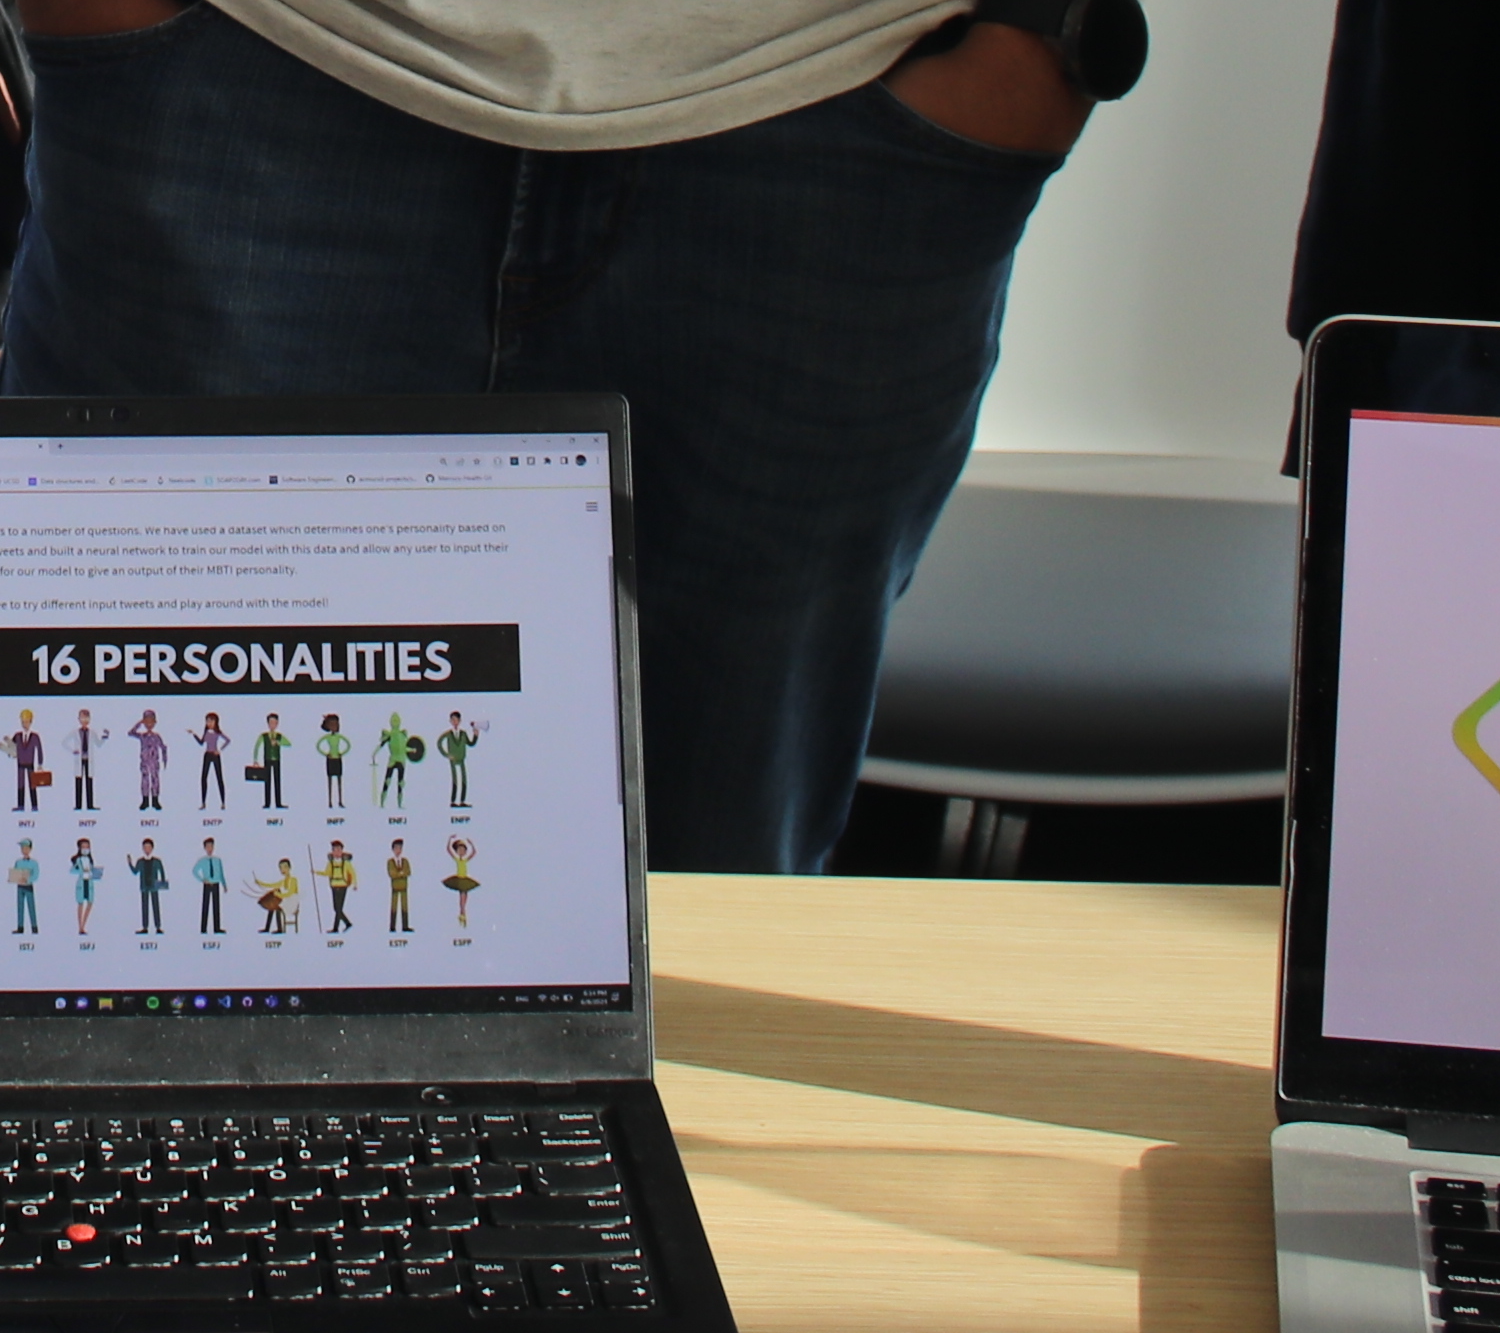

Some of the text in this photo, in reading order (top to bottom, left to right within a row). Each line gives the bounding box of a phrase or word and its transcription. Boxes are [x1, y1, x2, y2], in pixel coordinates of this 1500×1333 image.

[21, 527, 28, 536] a
[219, 526, 225, 535] a
[27, 546, 47, 556] and
[50, 546, 74, 556] built
[77, 548, 83, 556] a
[86, 546, 119, 556] neural
[122, 545, 166, 556] network
[168, 545, 179, 555] to
[182, 545, 206, 555] train
[209, 547, 227, 555] our
[230, 545, 263, 555] model
[266, 544, 289, 555] with
[291, 544, 311, 555] this
[313, 544, 337, 554] data
[339, 544, 359, 554] and
[363, 544, 390, 554] allow
[393, 544, 412, 556] any
[415, 545, 437, 554] user
[440, 543, 451, 554] to
[453, 543, 481, 555] input
[484, 543, 508, 553] their
[0, 566, 14, 576] for
[17, 568, 35, 576] our
[38, 566, 72, 576] model
[74, 566, 85, 576] to
[87, 566, 109, 578] give
[112, 567, 125, 576] an
[127, 565, 164, 578] output
[166, 565, 177, 575] of
[179, 565, 204, 575] their
[207, 565, 233, 575] MBTI
[236, 565, 297, 577] personality.
[10, 600, 20, 610] to
[23, 600, 38, 612] try
[41, 600, 86, 610] different
[89, 599, 116, 612] input
[120, 599, 154, 609] tweets
[157, 599, 177, 609] and
[180, 599, 202, 611] play
[205, 598, 243, 609] around
[246, 598, 269, 608] with
[272, 598, 288, 608] the
[32, 641, 453, 684] 16 PERSONALITIES
[3, 1173, 18, 1183] T
[70, 1171, 84, 1182] Y
